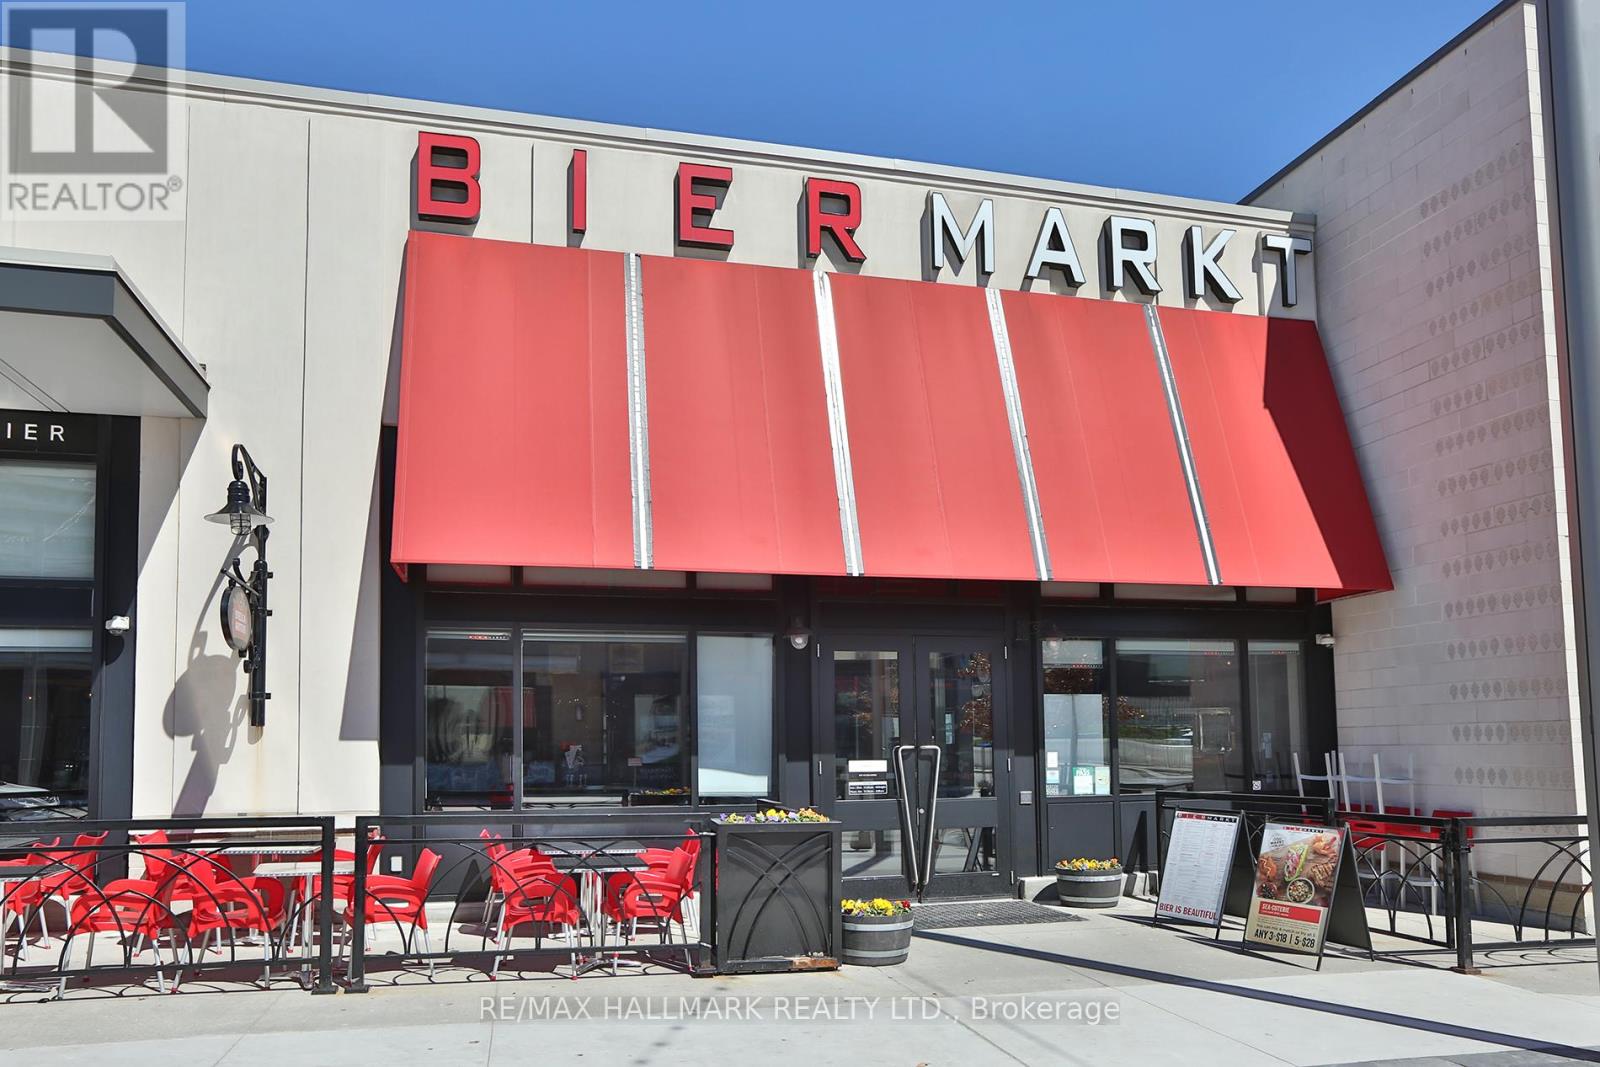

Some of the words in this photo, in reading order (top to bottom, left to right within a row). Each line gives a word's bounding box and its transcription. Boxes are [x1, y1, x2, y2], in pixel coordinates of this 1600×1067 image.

[418, 131, 867, 262] BIER
[931, 192, 1312, 307] MARKT
[1159, 902, 1174, 912] BIER
[1175, 905, 1182, 913] IS
[1255, 928, 1268, 939] ANY
